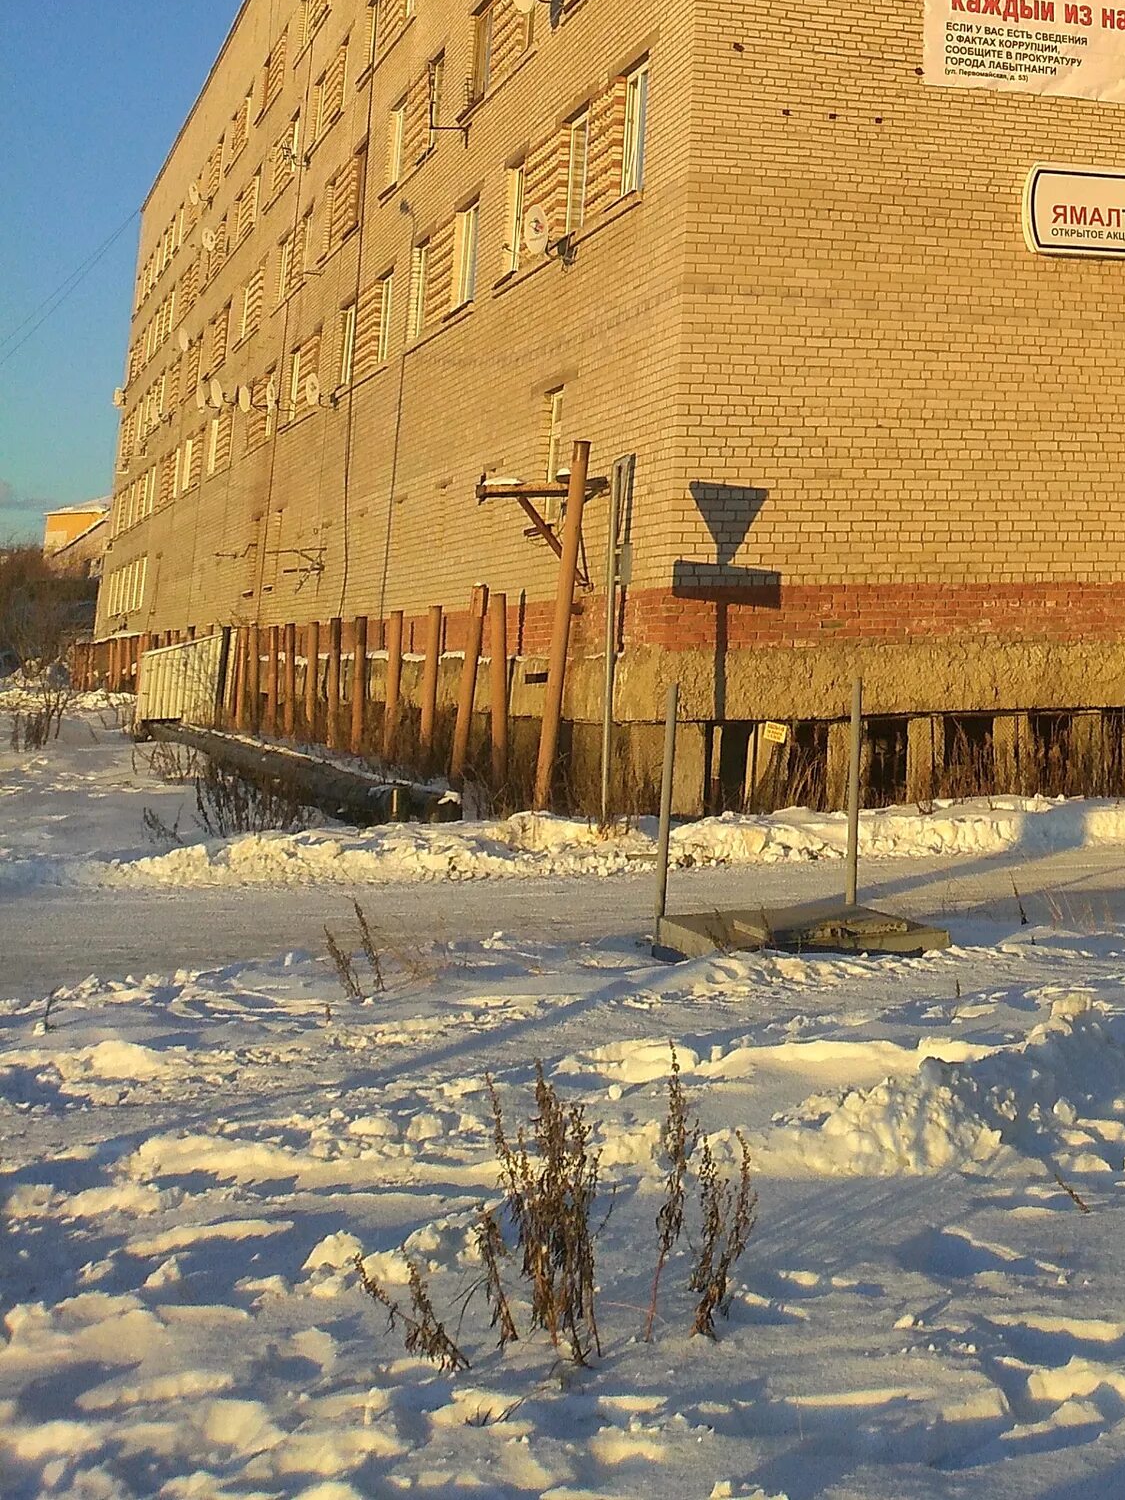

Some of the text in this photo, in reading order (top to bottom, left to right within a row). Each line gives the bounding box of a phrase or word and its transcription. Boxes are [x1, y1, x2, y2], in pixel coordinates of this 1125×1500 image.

[1065, 3, 1093, 26] из
[945, 33, 1060, 55] О ФАКТАХ КОРРУПЦИИ,
[946, 22, 1088, 46] ЕСЛИ У ВАС ЕСТЬ СВЕДЕНИЯ
[945, 45, 1082, 67] СООБЩИТЕ В ПРОКУРАТУРУ
[945, 56, 1057, 75] ГОРОДА ЛАБЫТНАНГИ
[1051, 228, 1104, 240] ОТКРЫТОЕ
